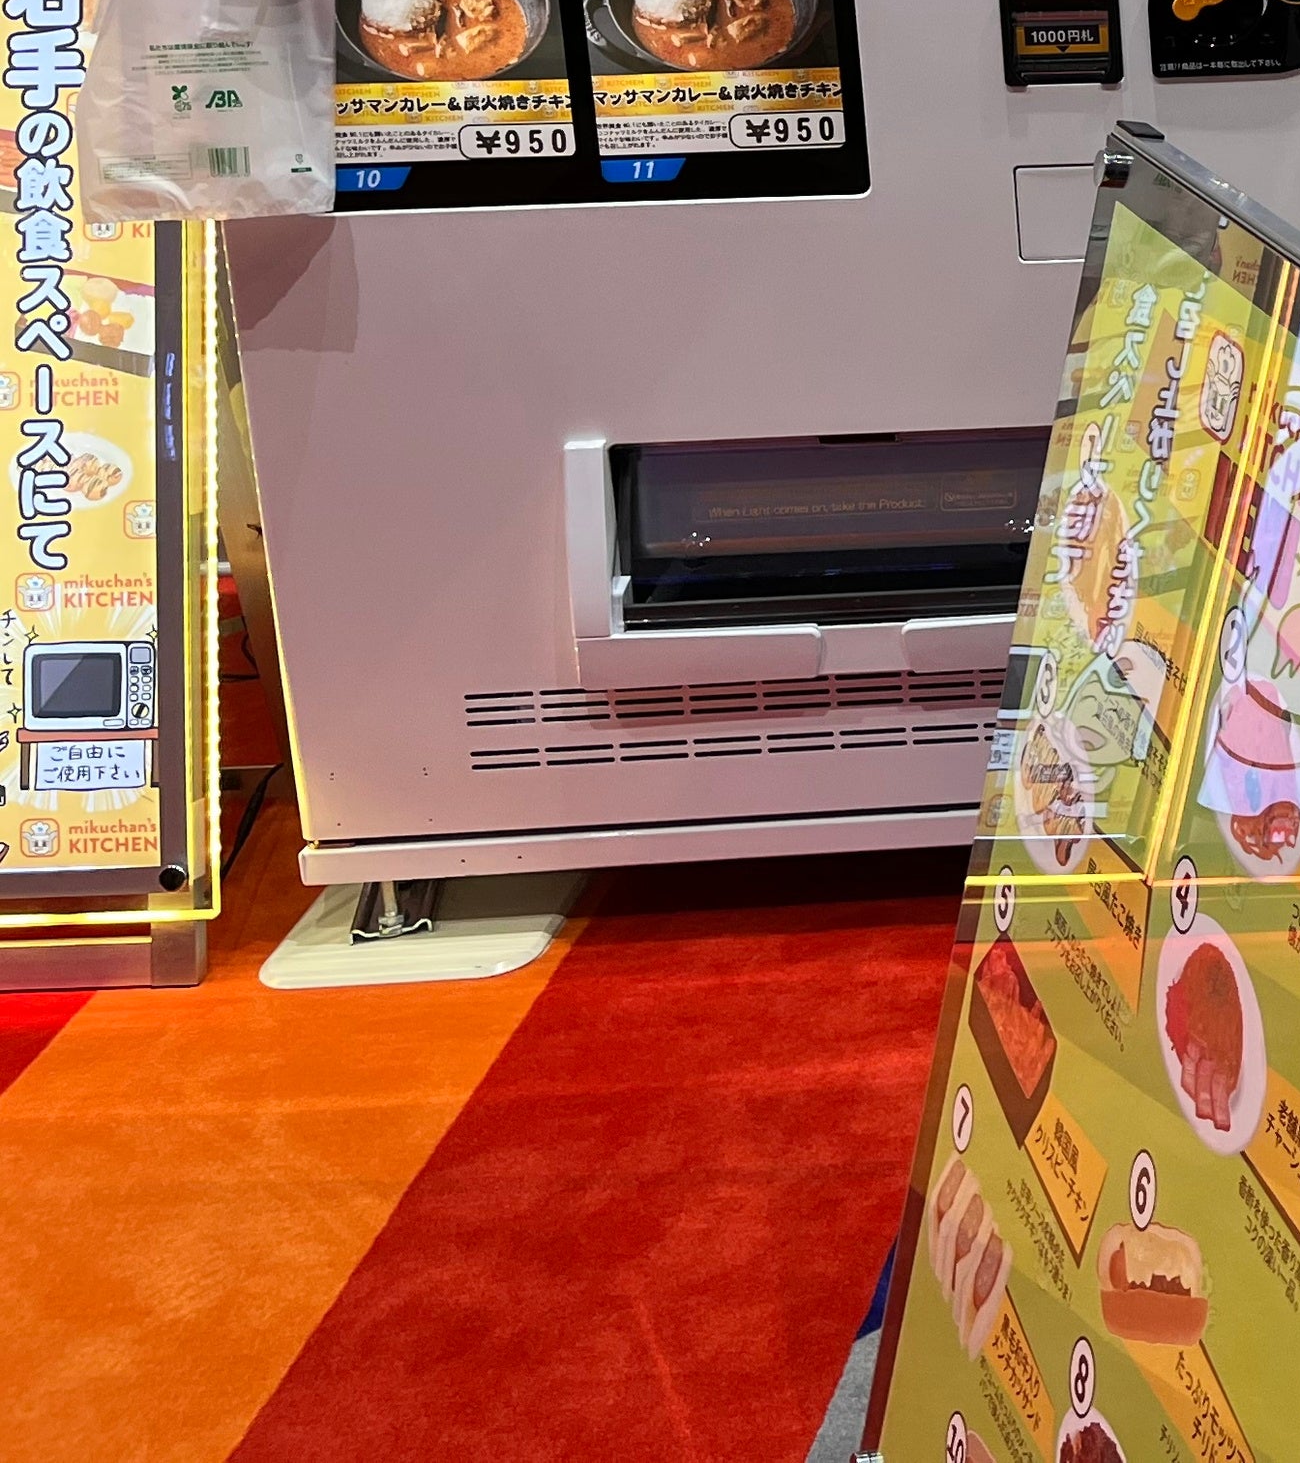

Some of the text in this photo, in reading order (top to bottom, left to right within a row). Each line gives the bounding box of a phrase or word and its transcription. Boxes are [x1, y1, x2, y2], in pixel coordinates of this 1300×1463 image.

[1031, 29, 1095, 44] 1000円札
[746, 116, 835, 145] ¥950
[476, 129, 567, 154] ¥950
[632, 160, 655, 179] 11
[356, 170, 381, 188] 10
[65, 574, 152, 589] mikuchan's
[64, 591, 153, 609] KITCHEN
[50, 745, 126, 761] ご自由に
[43, 766, 141, 783] ご使用下さい
